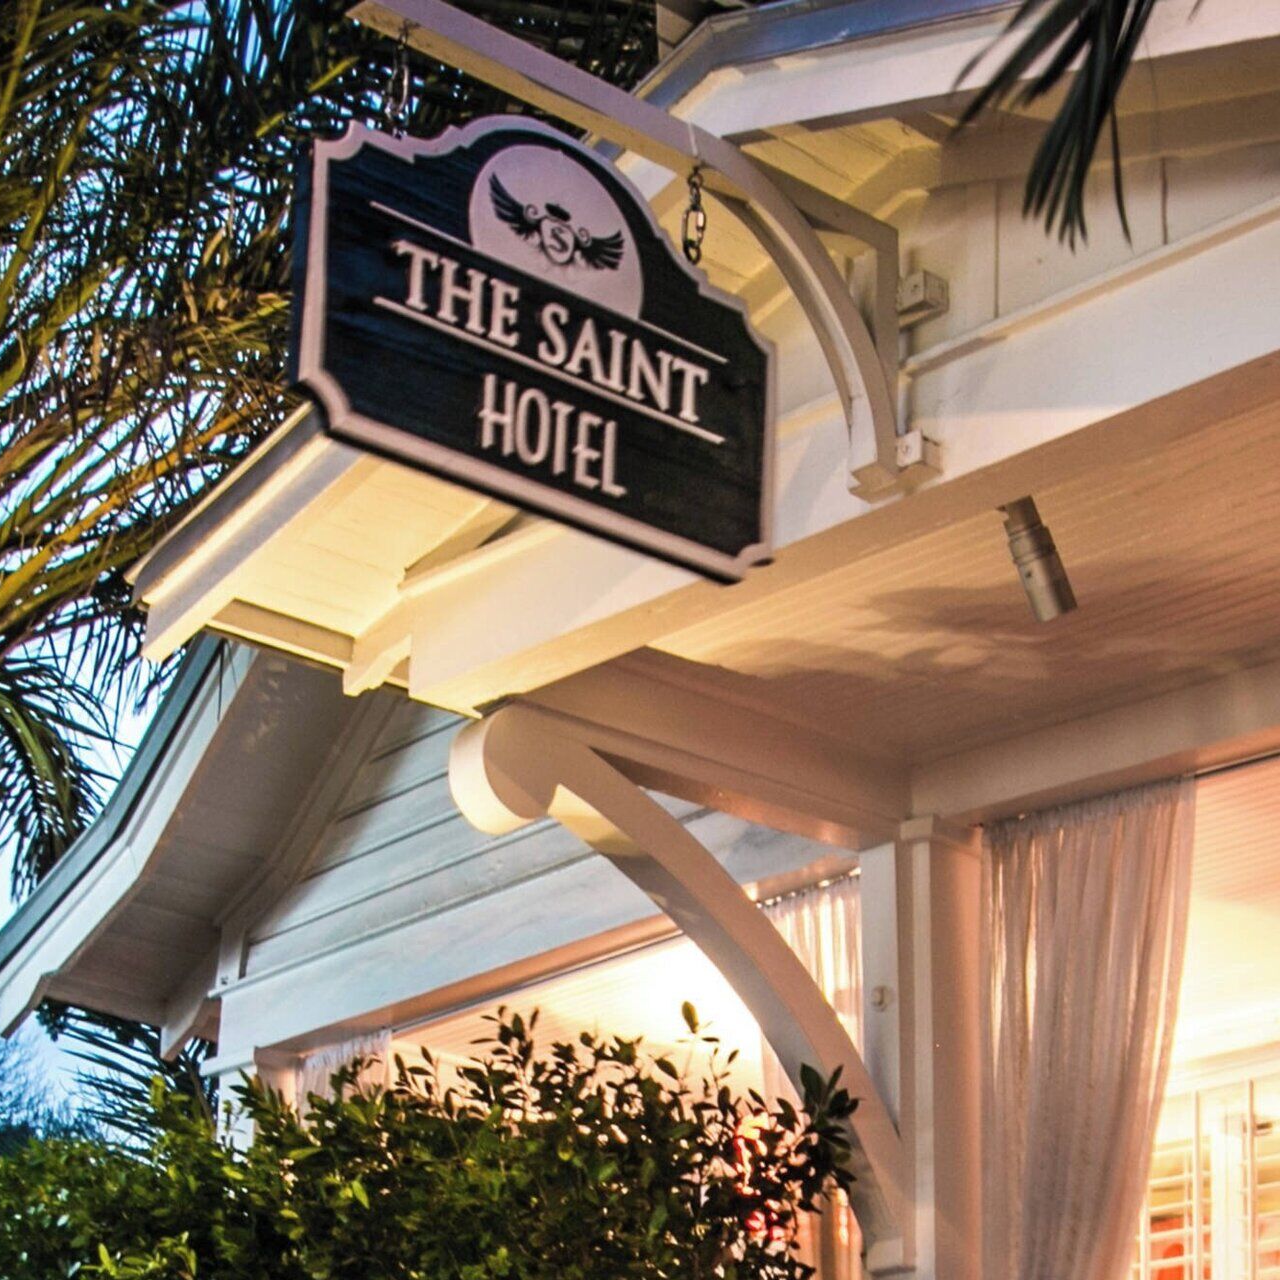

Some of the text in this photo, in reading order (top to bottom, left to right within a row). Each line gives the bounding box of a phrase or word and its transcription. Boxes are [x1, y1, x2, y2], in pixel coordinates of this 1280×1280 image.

[548, 226, 570, 253] S
[394, 240, 708, 422] THE SAINT
[479, 374, 626, 497] HOTEL
